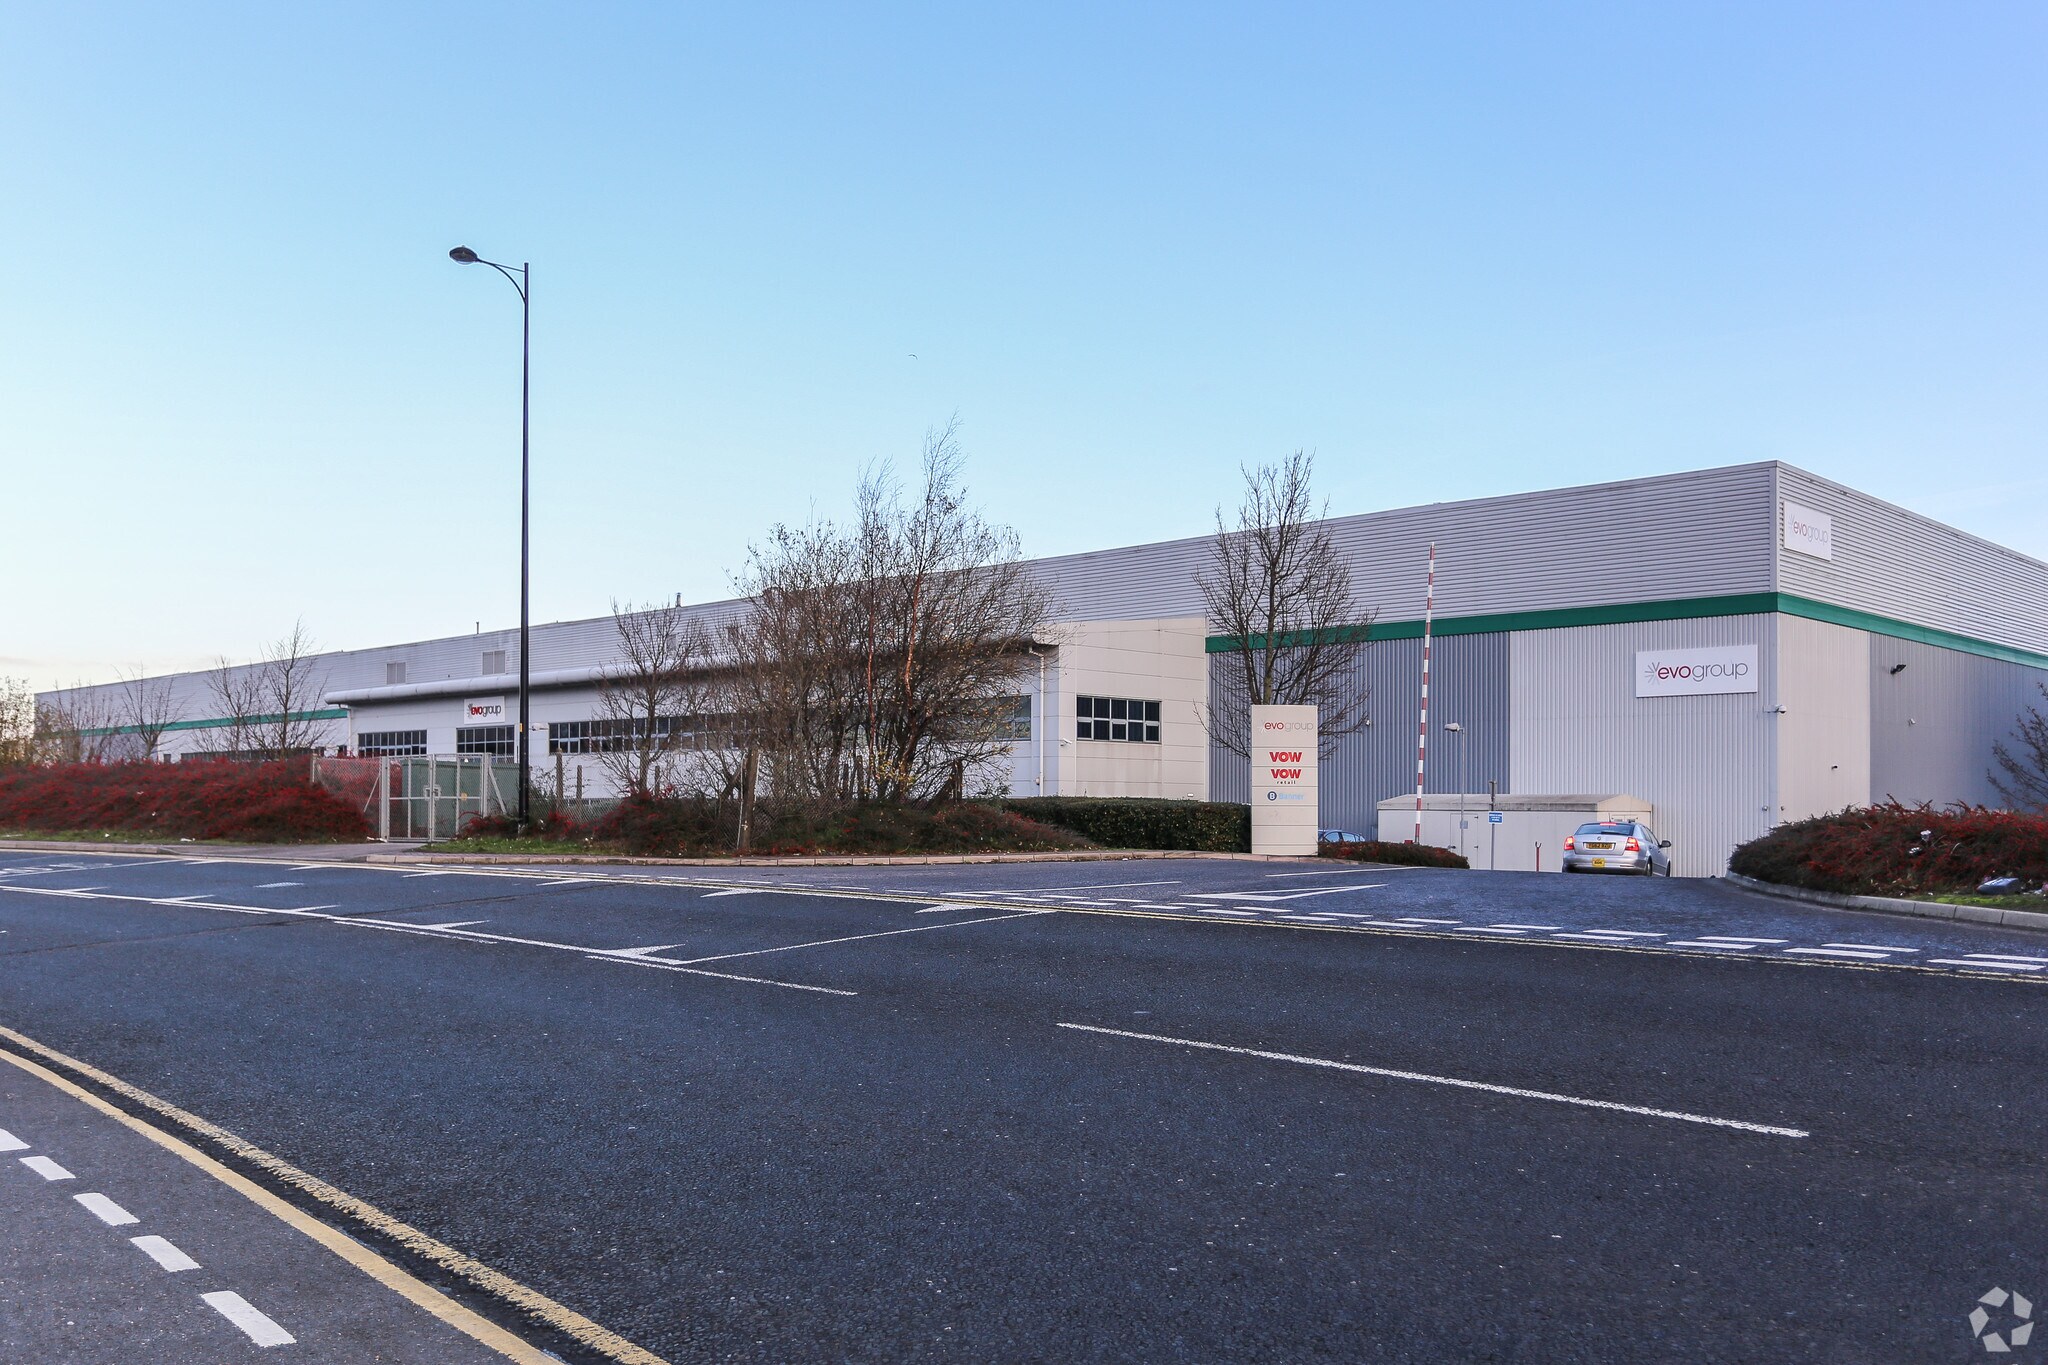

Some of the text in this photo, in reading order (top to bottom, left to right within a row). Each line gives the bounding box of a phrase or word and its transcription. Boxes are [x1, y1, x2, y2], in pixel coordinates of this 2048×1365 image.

[1657, 662, 1749, 682] evogroup
[471, 705, 502, 717] evogroup
[1264, 721, 1314, 732] evogroup
[1269, 752, 1303, 763] VOW
[1270, 768, 1302, 779] VOW
